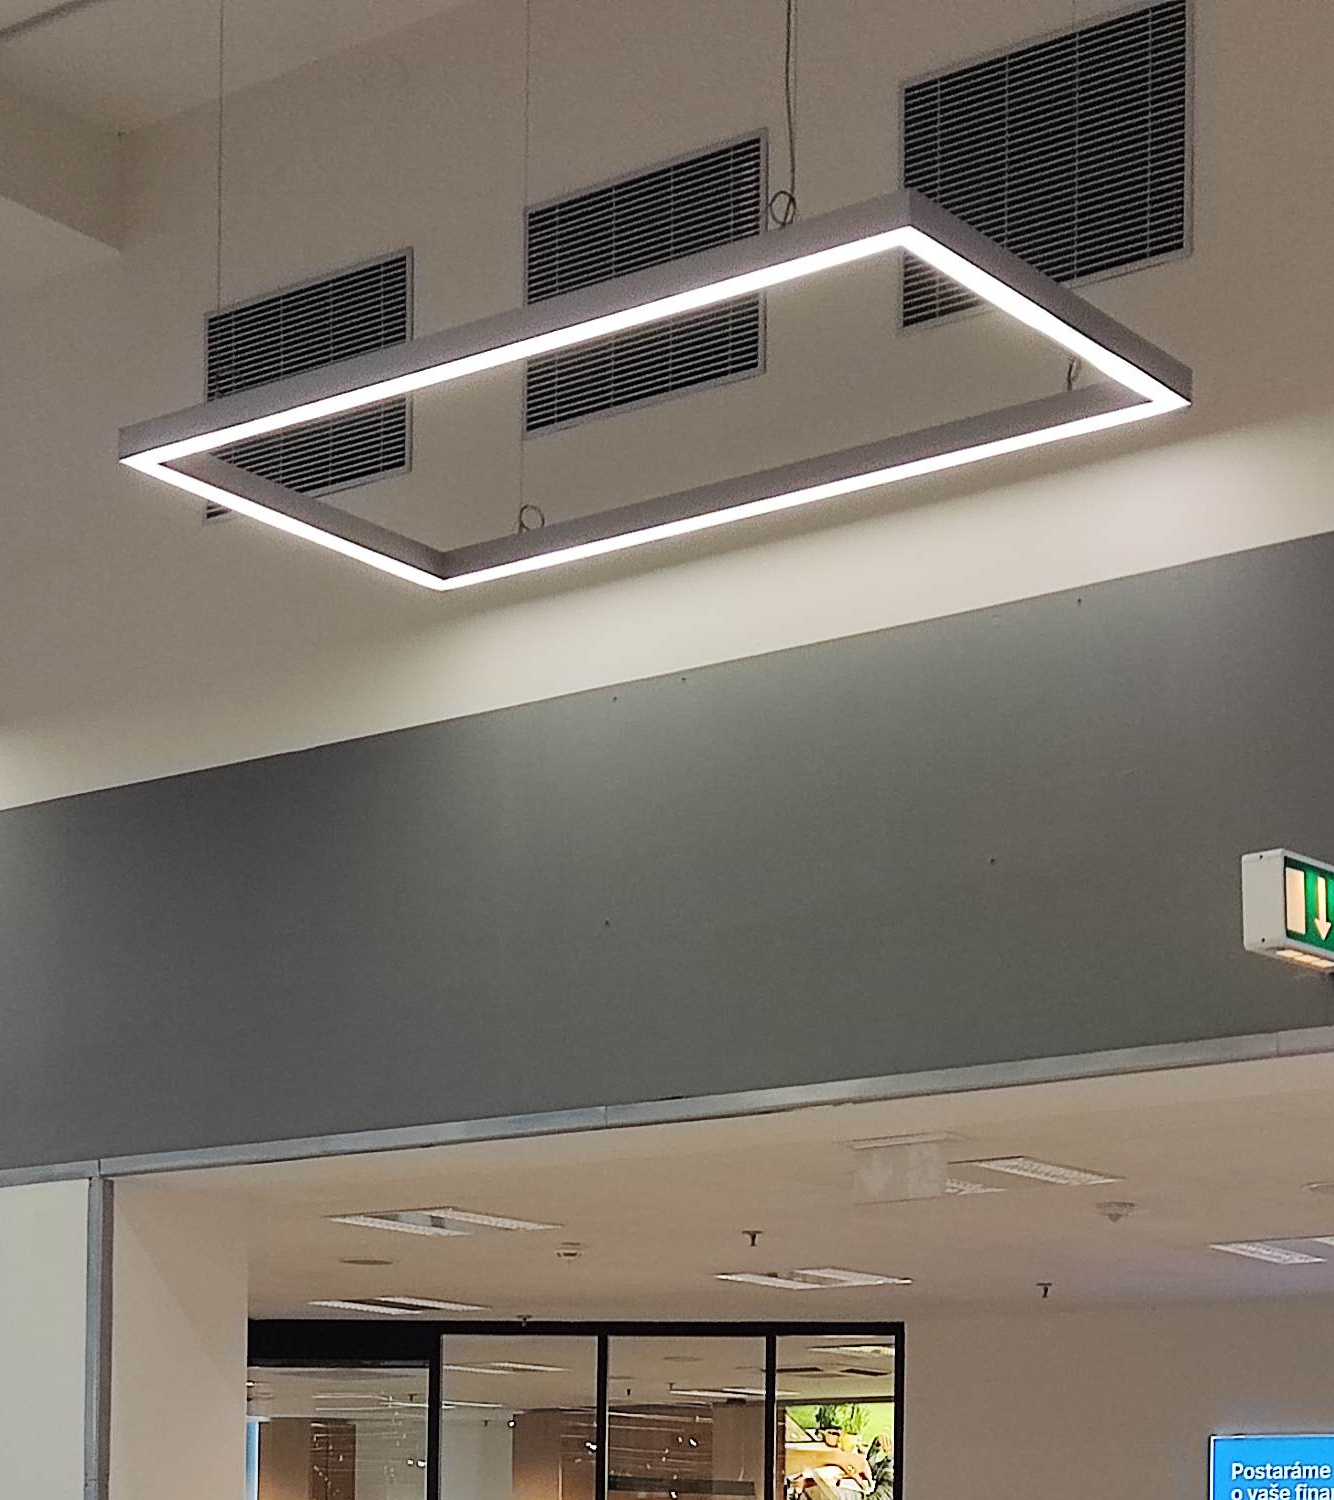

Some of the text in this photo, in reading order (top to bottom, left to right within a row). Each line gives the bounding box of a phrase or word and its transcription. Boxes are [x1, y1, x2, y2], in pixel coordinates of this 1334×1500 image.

[1231, 1462, 1331, 1480] Postaráme
[1231, 1488, 1243, 1500] o
[1247, 1484, 1291, 1500] vaše
